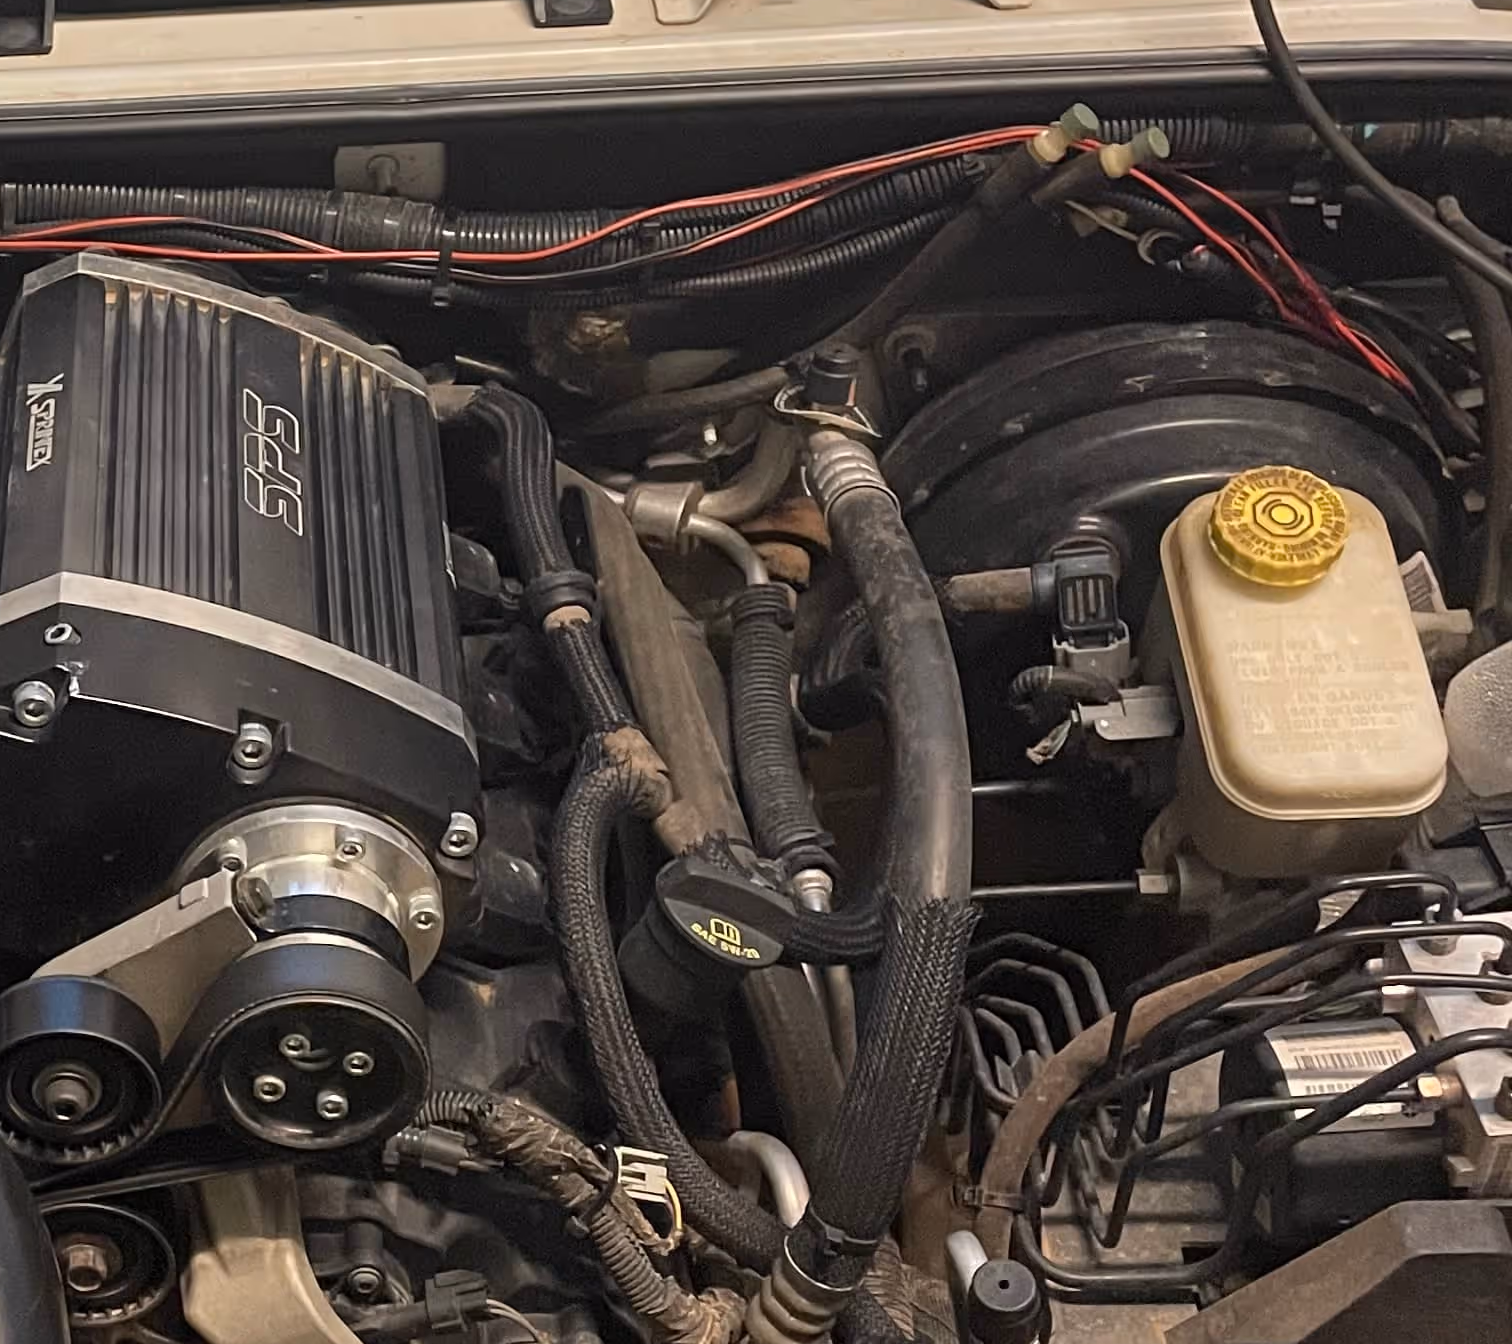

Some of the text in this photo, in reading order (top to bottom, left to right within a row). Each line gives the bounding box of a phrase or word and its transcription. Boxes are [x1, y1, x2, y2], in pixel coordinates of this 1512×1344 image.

[26, 398, 56, 472] SPRINTEX
[243, 388, 304, 537] SPS
[690, 922, 717, 946] SAE
